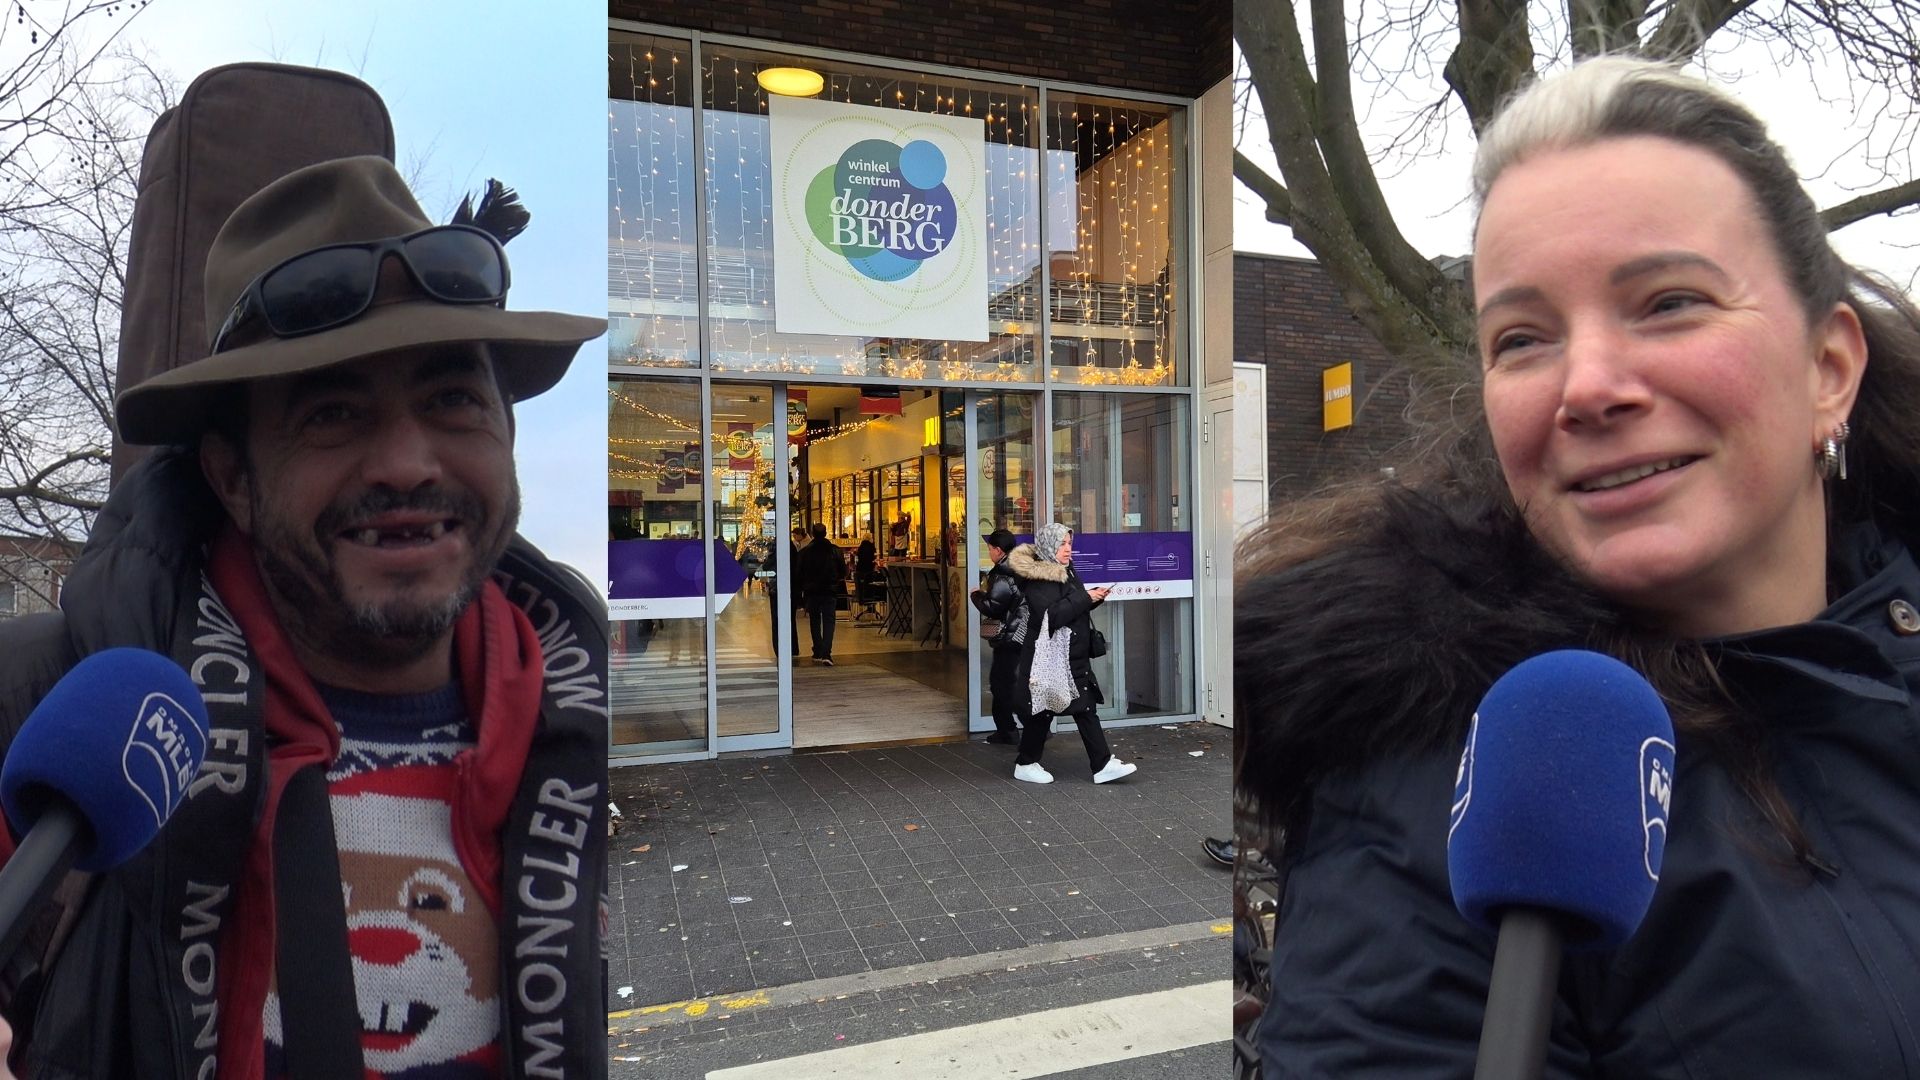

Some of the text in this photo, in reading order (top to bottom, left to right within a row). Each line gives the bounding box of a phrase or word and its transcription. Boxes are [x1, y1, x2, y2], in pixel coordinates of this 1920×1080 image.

[848, 158, 891, 174] winkel
[848, 174, 901, 188] centrum
[829, 188, 942, 222] donder
[829, 213, 946, 254] BERG
[787, 418, 806, 426] ERG
[190, 568, 251, 800] ONCLER
[515, 777, 599, 1080] MONCLER
